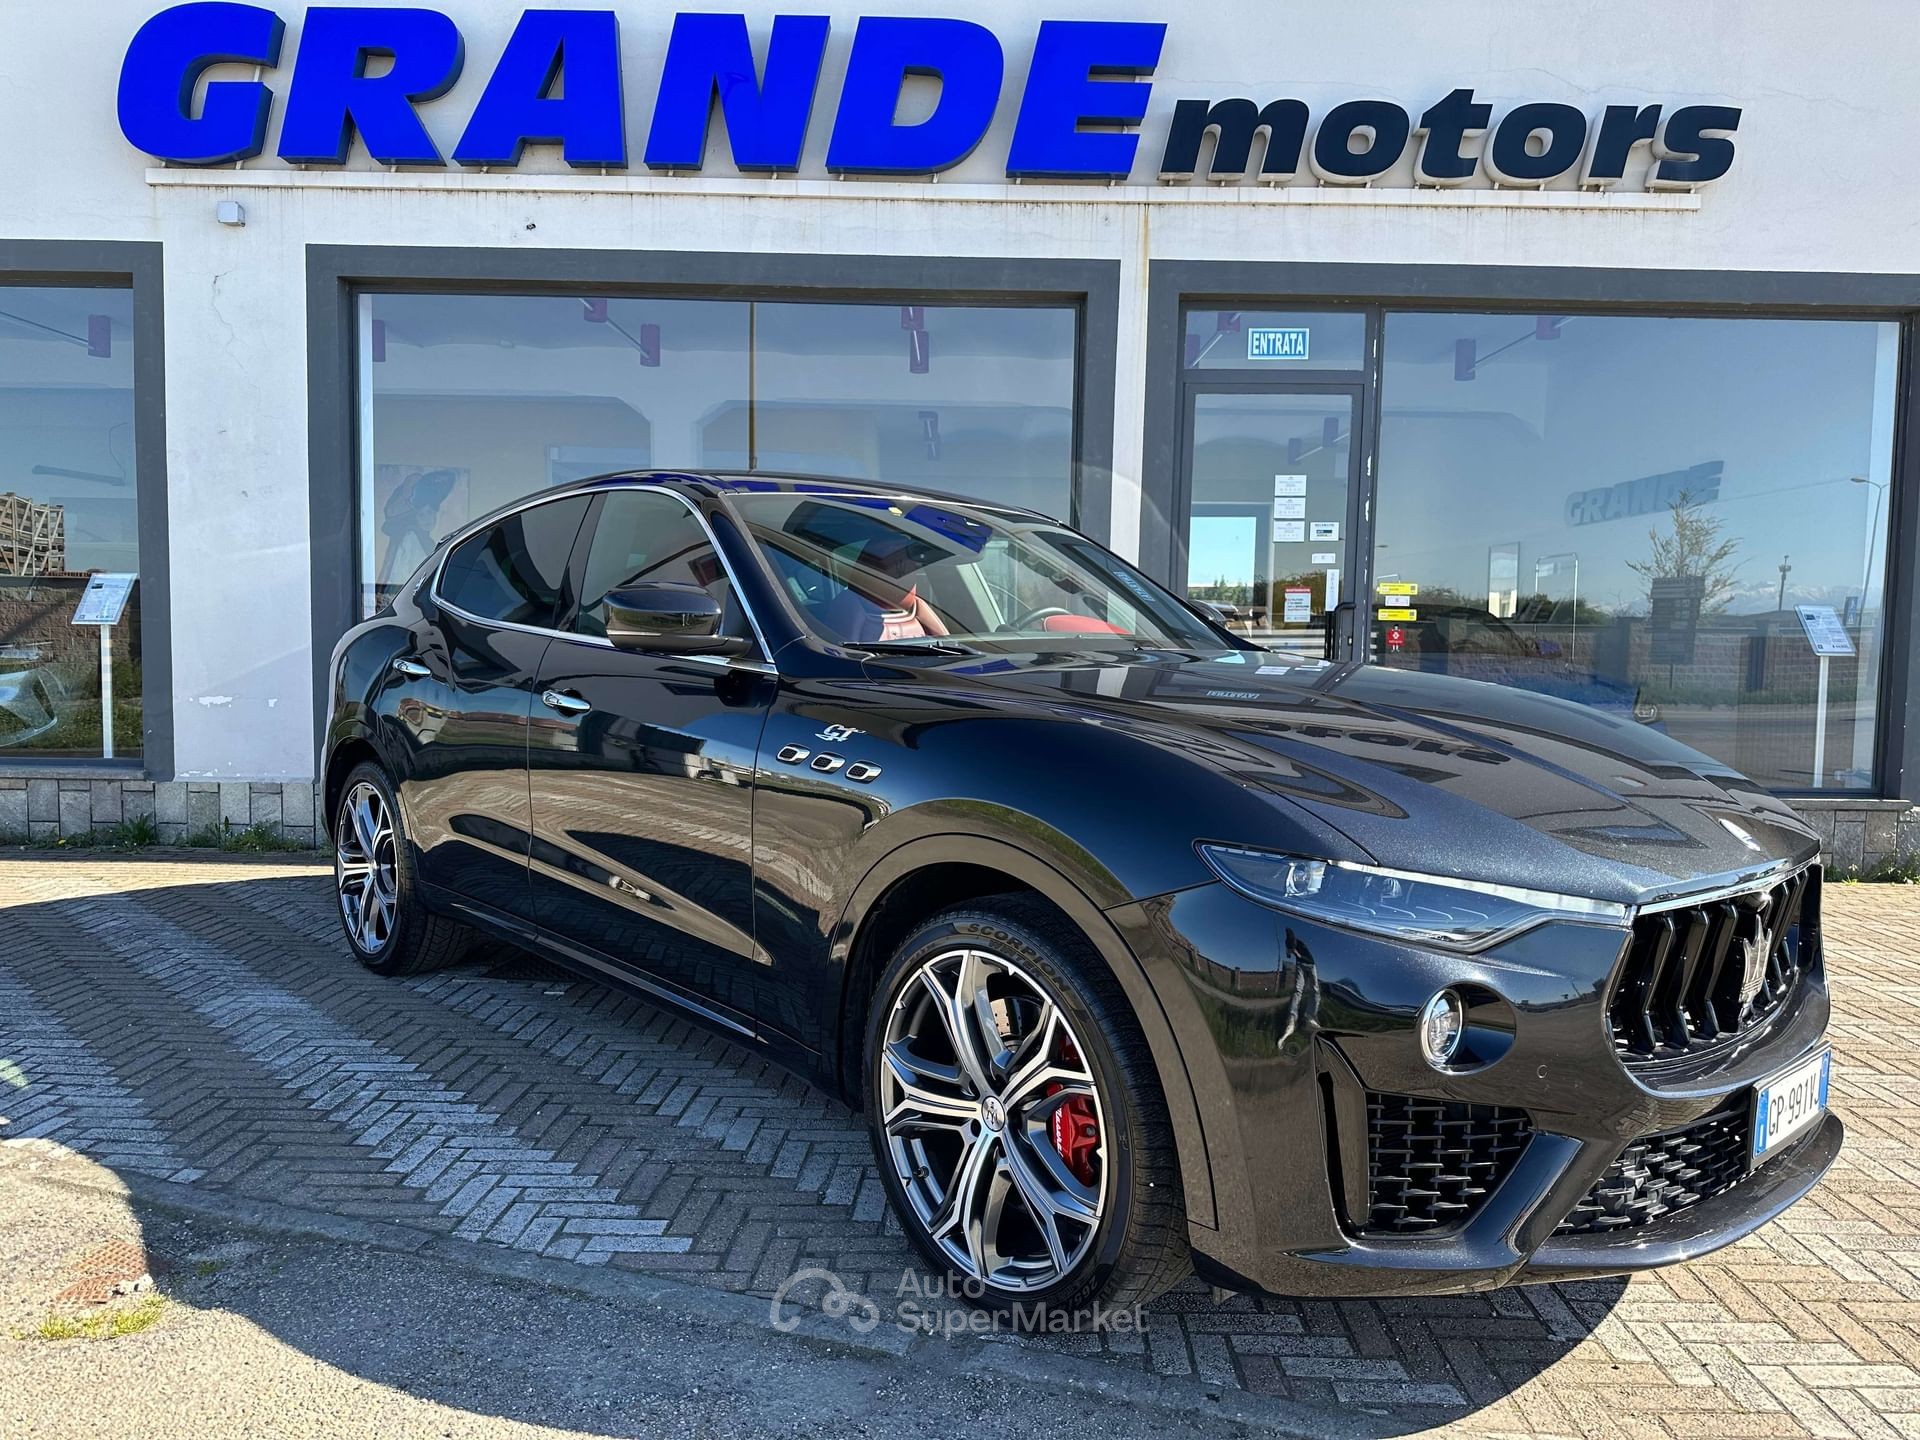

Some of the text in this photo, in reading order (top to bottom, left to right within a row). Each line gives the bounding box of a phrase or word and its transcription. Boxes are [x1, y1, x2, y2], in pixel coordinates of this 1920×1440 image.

[117, 1, 1742, 189] GRANDE motors
[1253, 332, 1304, 355] ENTRATA
[967, 923, 1072, 992] SCORPION
